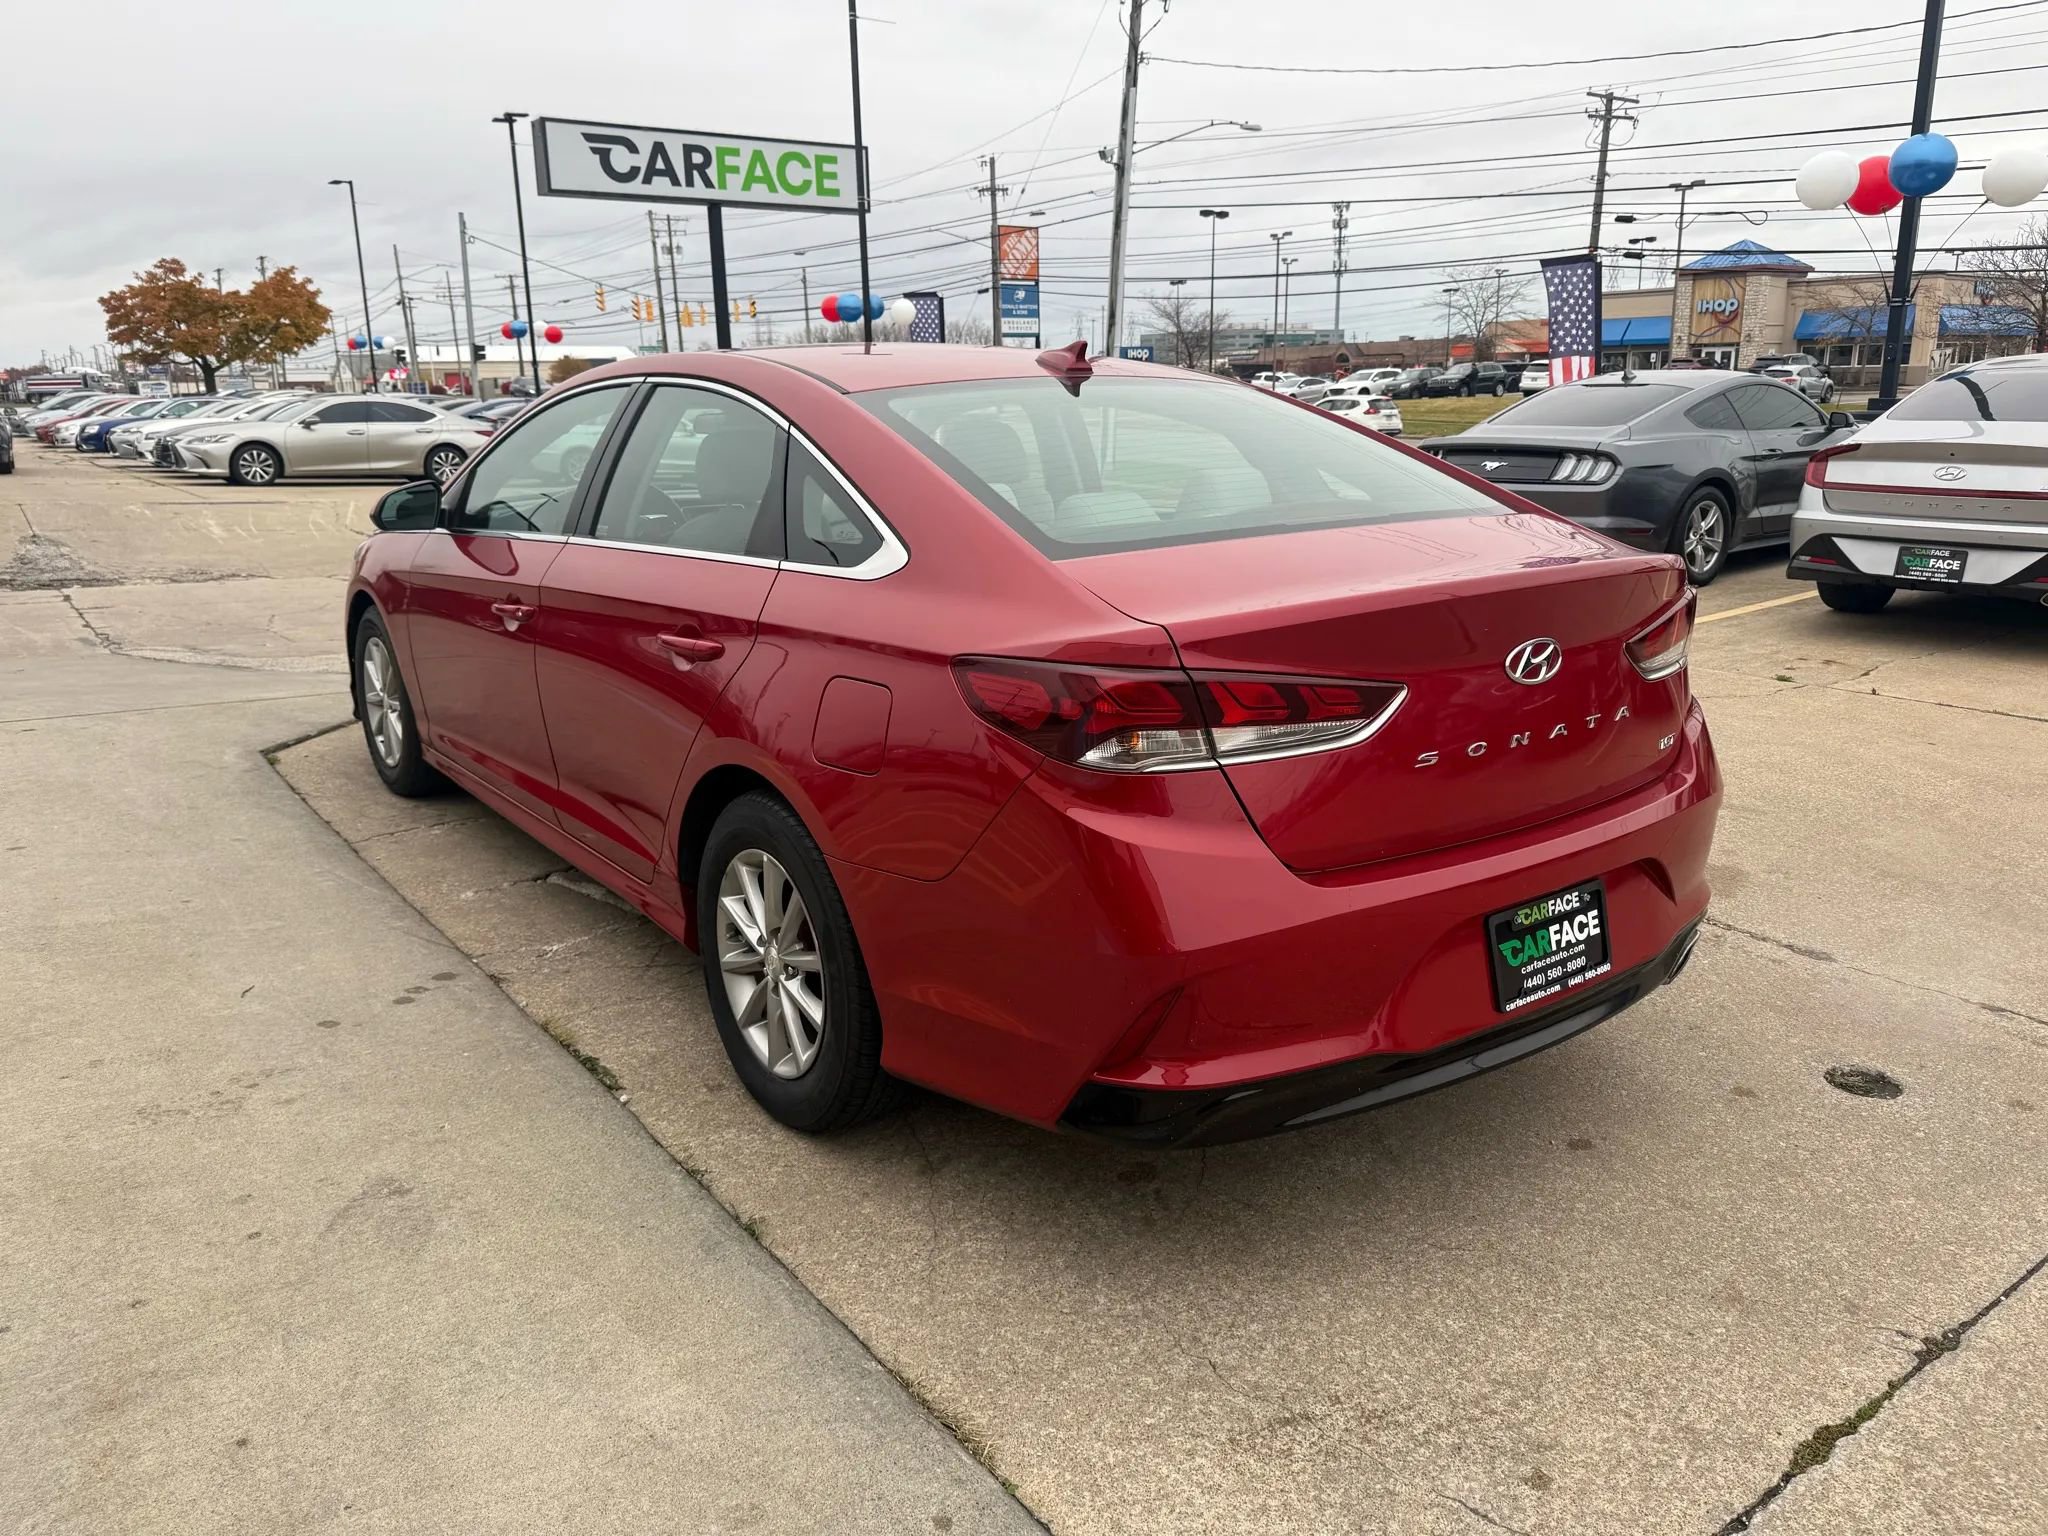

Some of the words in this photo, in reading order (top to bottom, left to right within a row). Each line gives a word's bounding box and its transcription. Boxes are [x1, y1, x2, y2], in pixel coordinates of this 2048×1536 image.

[580, 132, 841, 198] CARFACE
[1696, 297, 1739, 316] IHOP
[1127, 349, 1149, 360] IHOP
[1903, 556, 1961, 570] CARFACE
[1912, 548, 1950, 556] CARFACE
[1414, 706, 1630, 768] SONATA
[1518, 892, 1580, 925] CARFACE
[1499, 909, 1600, 967] CARFACE
[1521, 944, 1585, 974] carfaceauto.com
[1505, 984, 1560, 1011] carfaceauto.com
[1568, 974, 1584, 988] (440)
[1523, 973, 1545, 988] (440)
